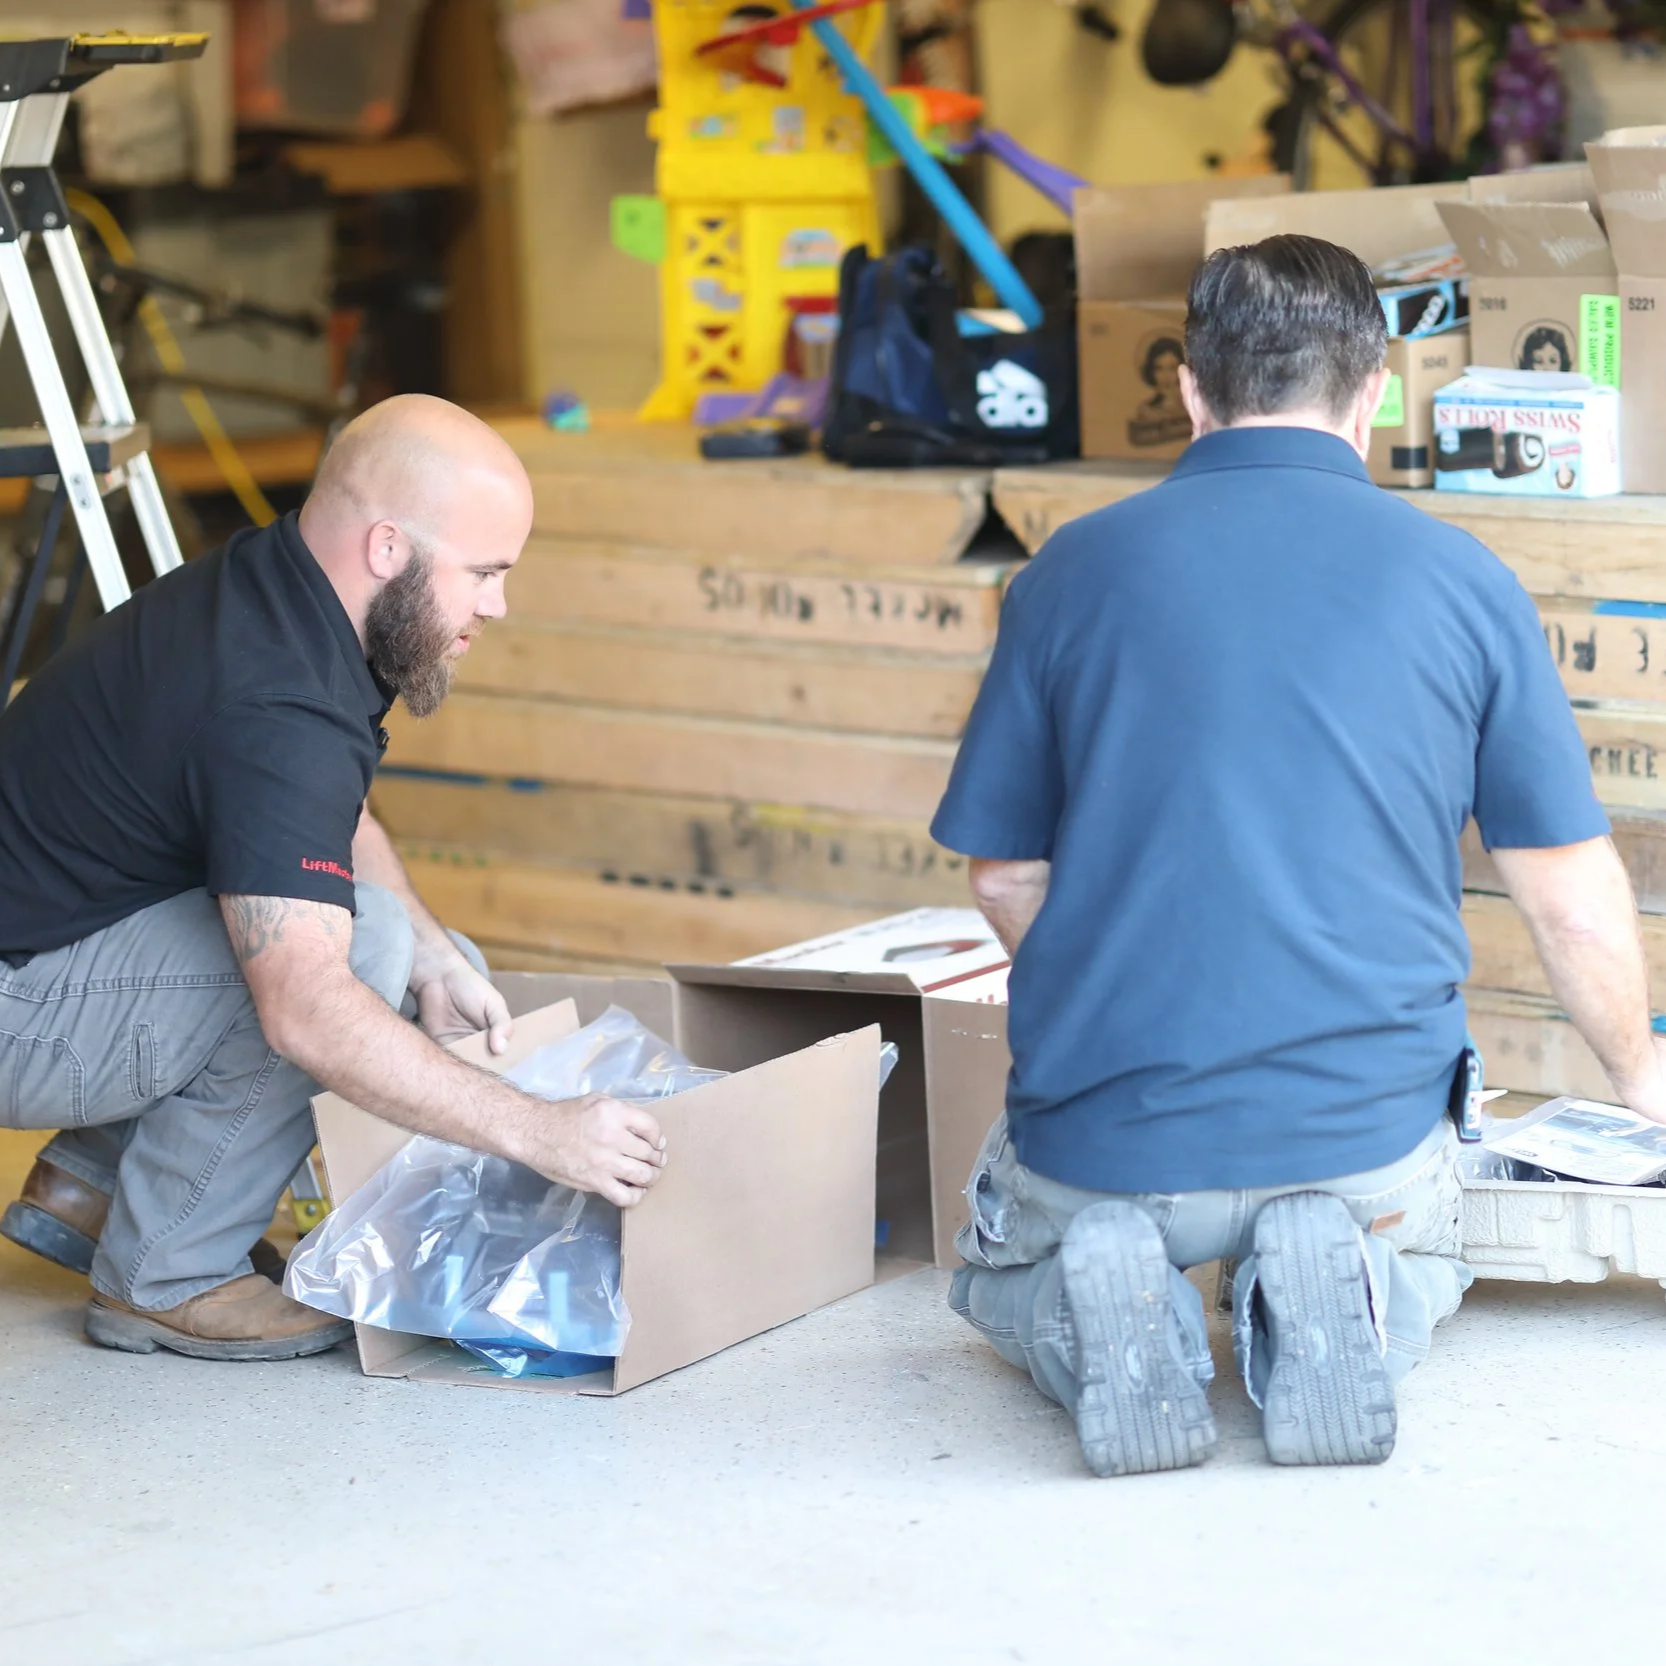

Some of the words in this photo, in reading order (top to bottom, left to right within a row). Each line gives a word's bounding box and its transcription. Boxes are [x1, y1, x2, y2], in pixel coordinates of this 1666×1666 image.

[1628, 297, 1655, 311] 5221
[1439, 407, 1507, 433] ROLLS
[1514, 407, 1581, 433] SWISS
